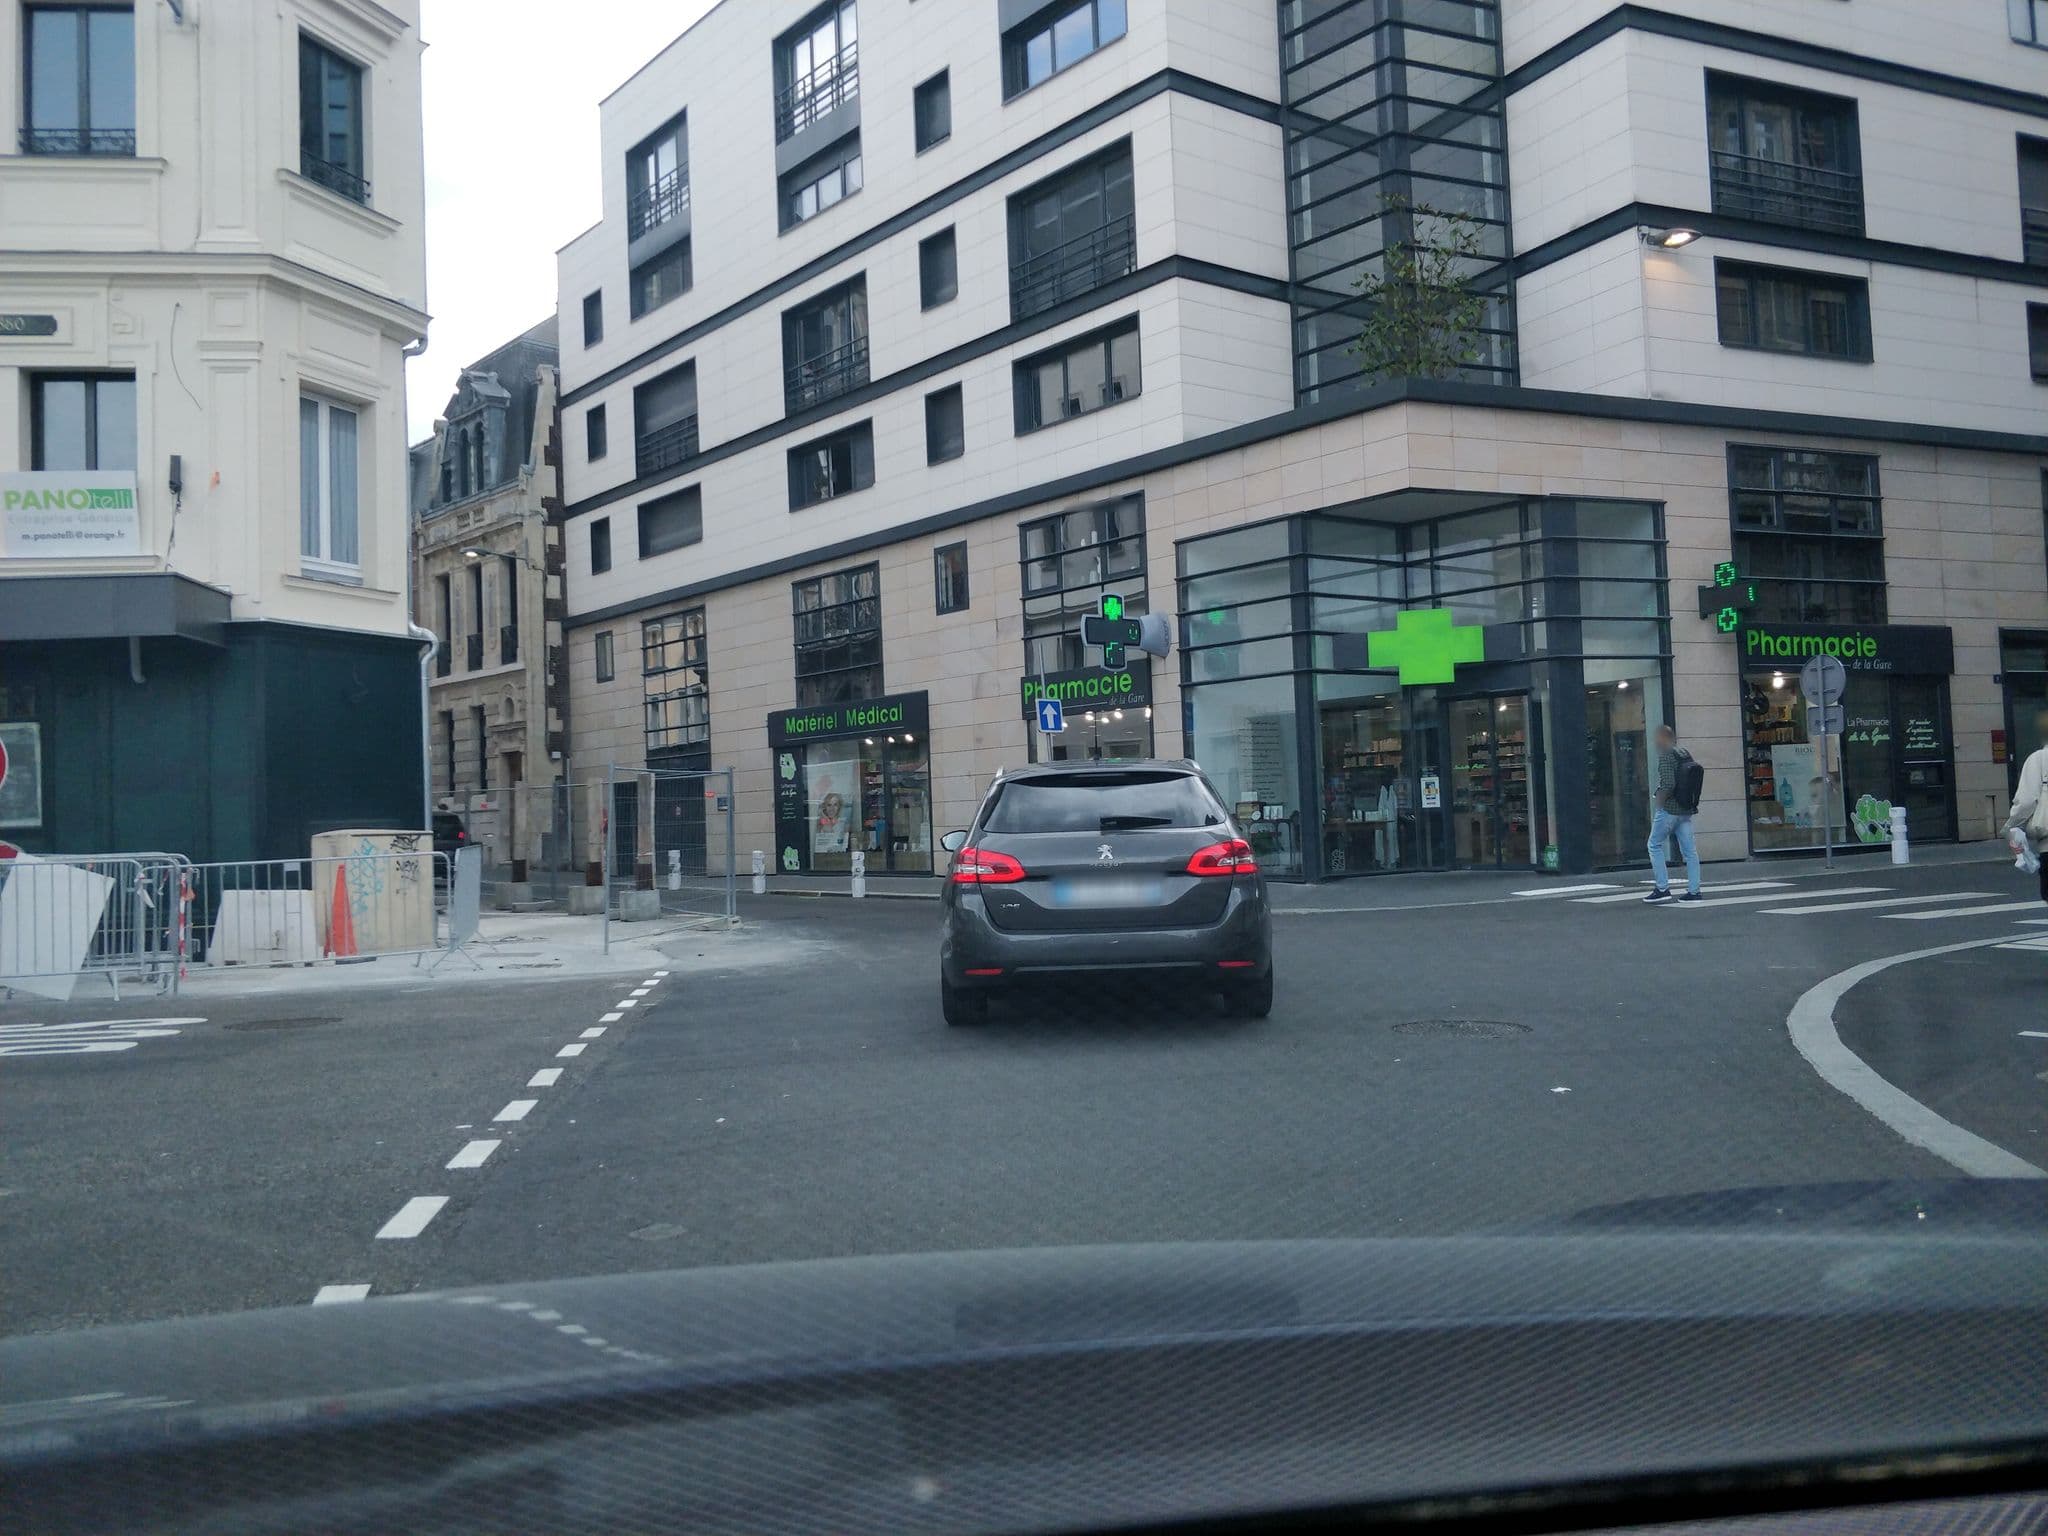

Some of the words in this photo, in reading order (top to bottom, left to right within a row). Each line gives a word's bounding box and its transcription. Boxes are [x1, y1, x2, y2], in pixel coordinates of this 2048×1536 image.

[1746, 629, 1877, 657] Pharmacie
[1852, 660, 1862, 670] de
[1863, 660, 1871, 670] la
[1873, 659, 1892, 670] Gare
[1023, 672, 1132, 705] Pharmacie
[1127, 693, 1145, 704] Gare
[785, 711, 838, 734] Matériel
[846, 702, 903, 727] Médical
